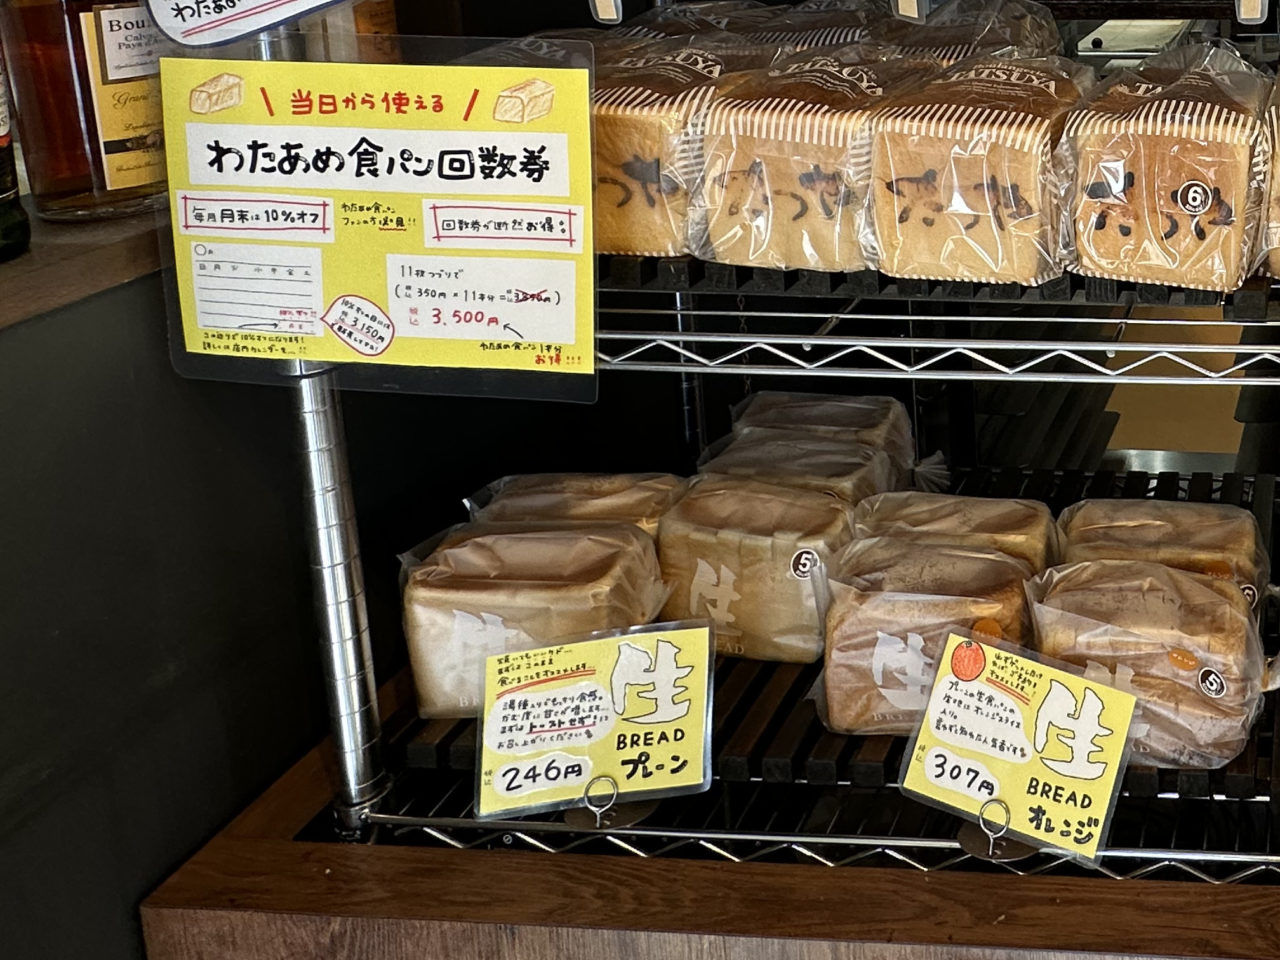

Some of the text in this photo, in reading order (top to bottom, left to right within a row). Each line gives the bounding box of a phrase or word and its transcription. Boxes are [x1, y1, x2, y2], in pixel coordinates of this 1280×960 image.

[290, 89, 445, 117] 当日から使える
[206, 136, 550, 183] わたあめ食パン回数券
[1188, 186, 1203, 206] 6
[192, 205, 320, 224] 毎月月末は10%オフ
[616, 728, 686, 751] BREAD
[502, 759, 582, 792] 246円
[621, 751, 689, 780] プレーン
[934, 752, 995, 797] 307円
[1026, 776, 1092, 809] BREAD
[1028, 804, 1100, 845] オレンジ
